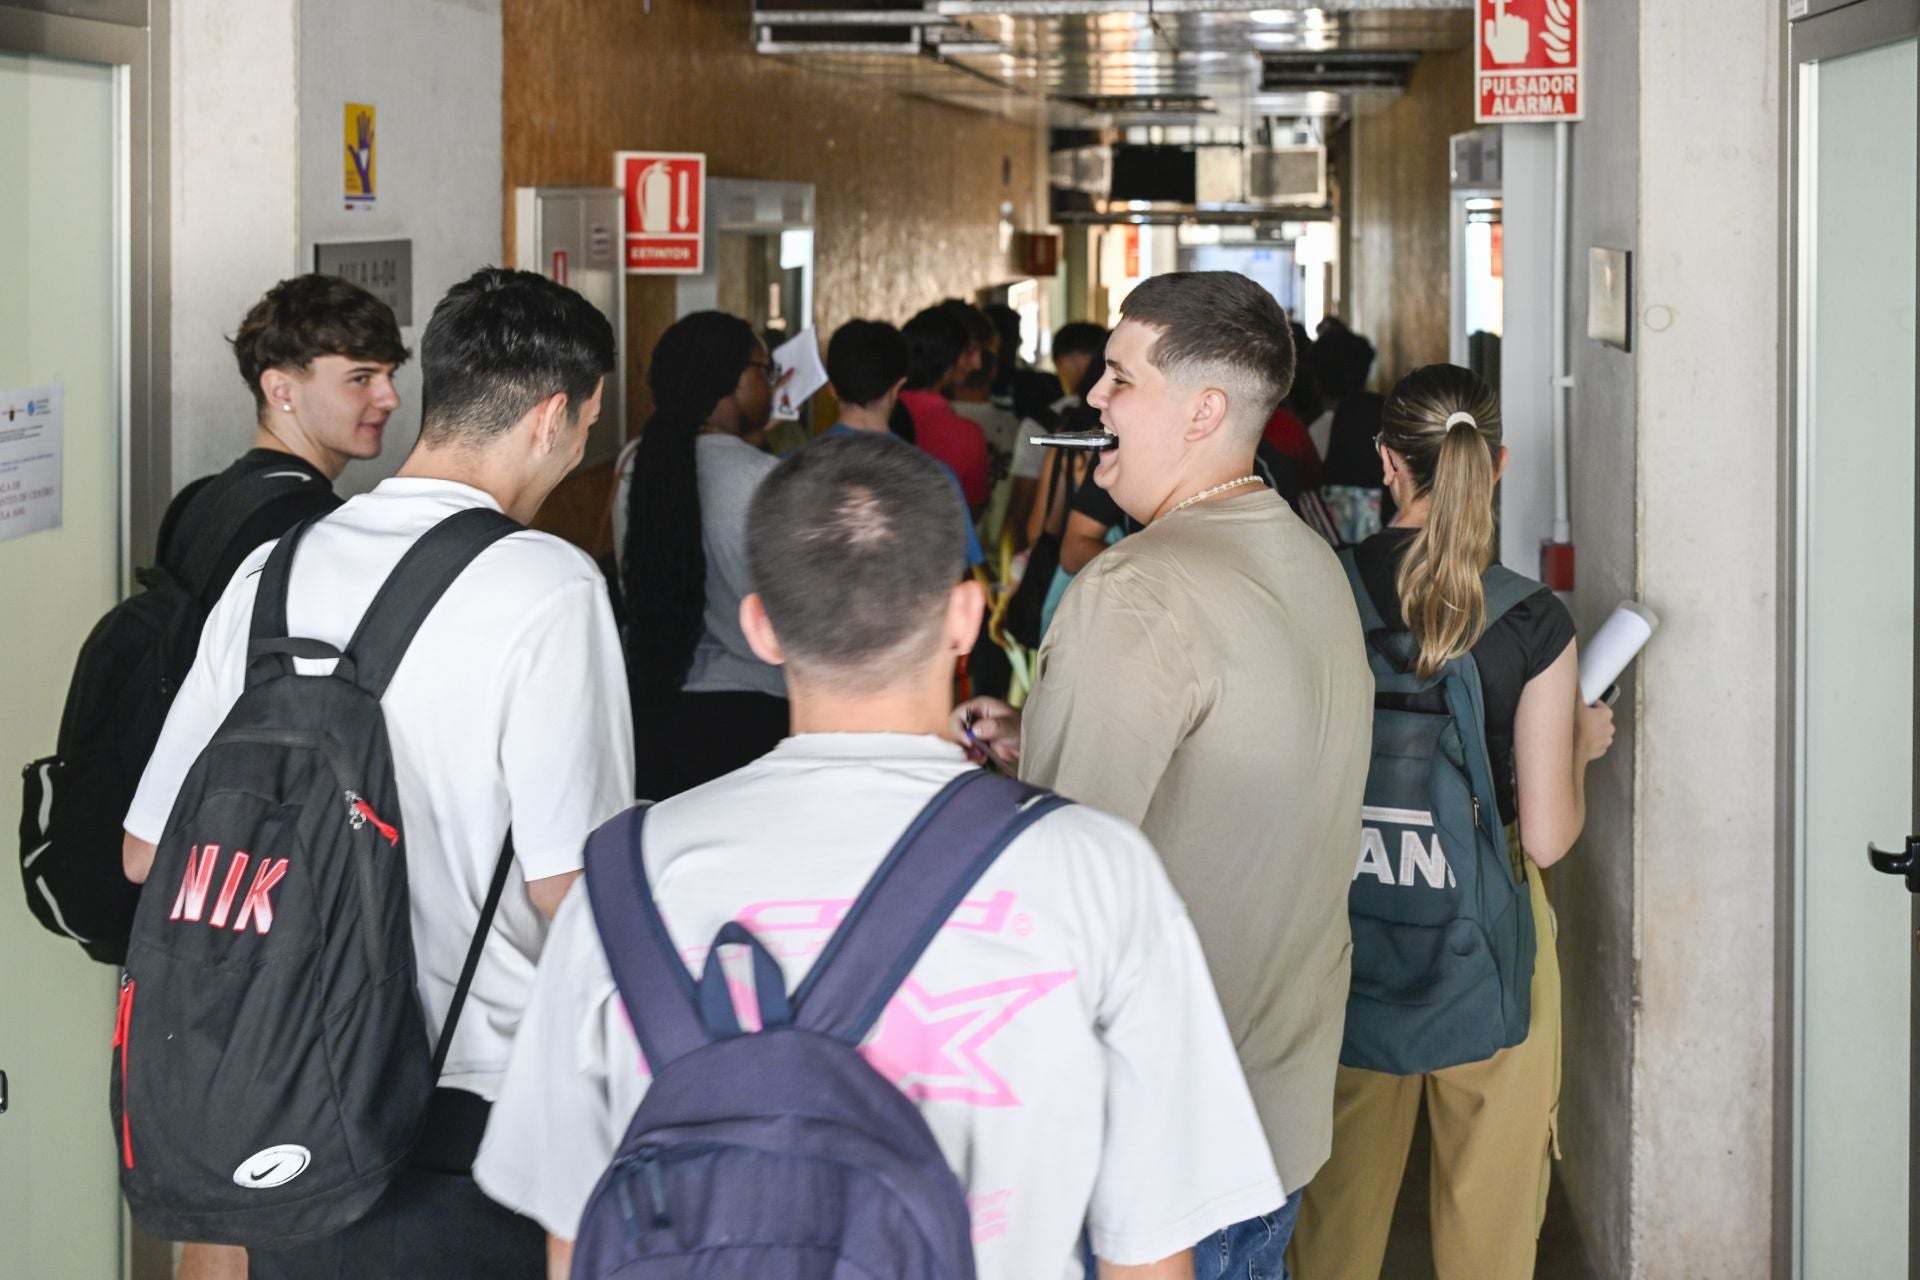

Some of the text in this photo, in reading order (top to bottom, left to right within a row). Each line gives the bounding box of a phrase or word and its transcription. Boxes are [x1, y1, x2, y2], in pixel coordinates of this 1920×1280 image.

[1482, 75, 1575, 96] PULSADOR
[1492, 95, 1565, 114] ALARMA
[1352, 827, 1456, 888] AN
